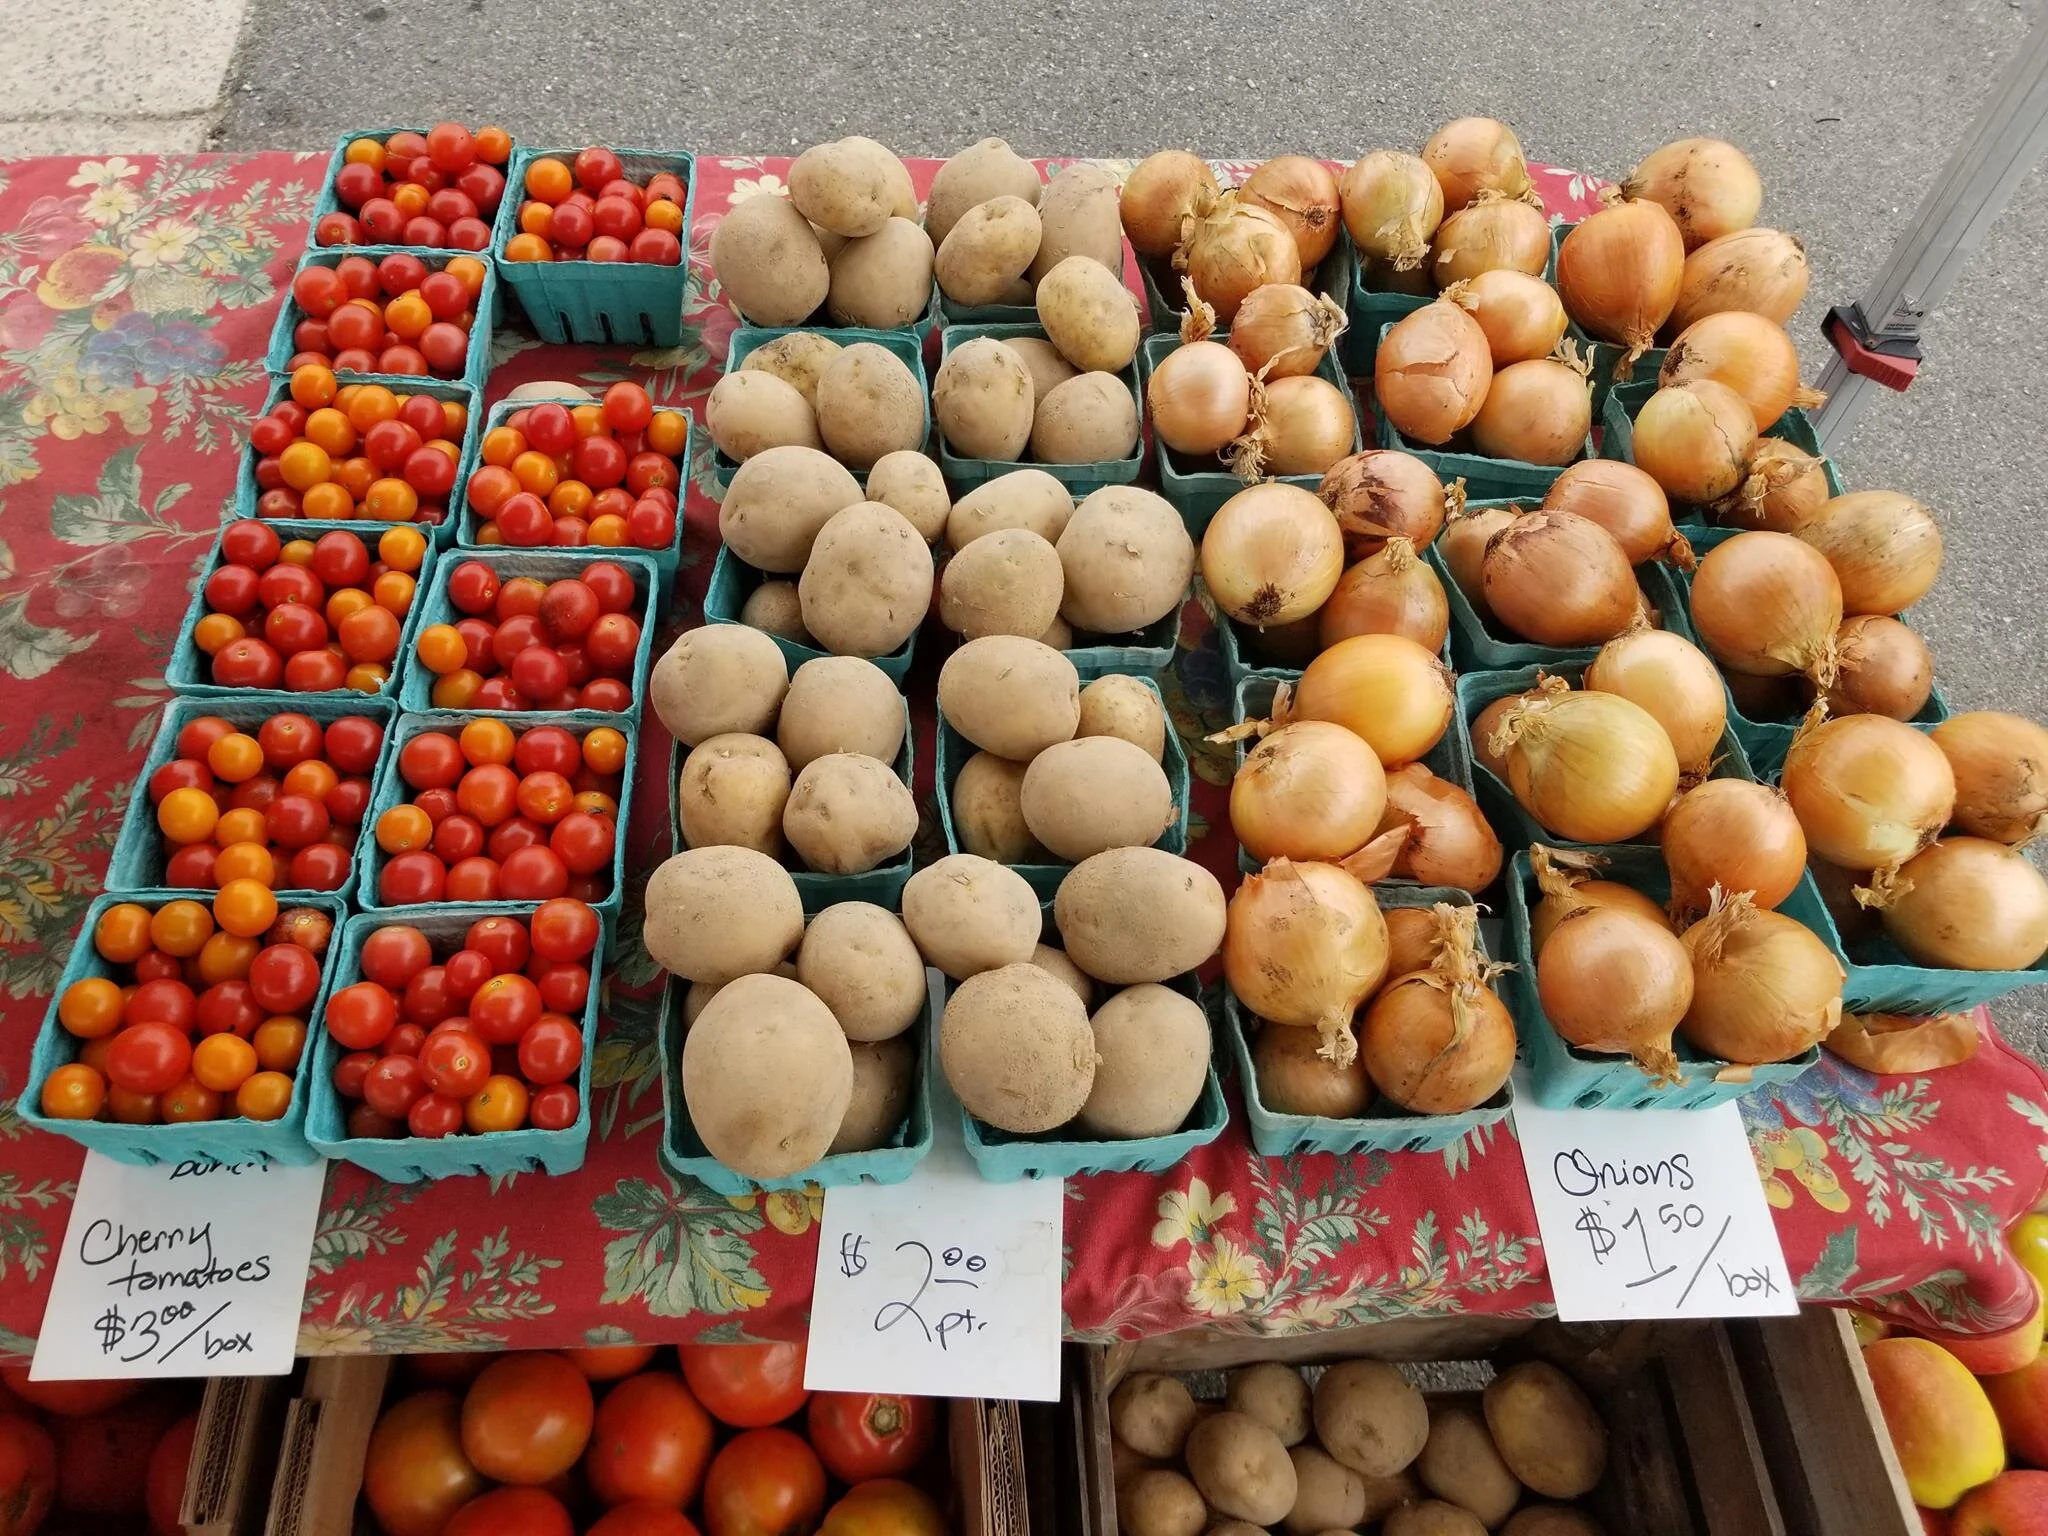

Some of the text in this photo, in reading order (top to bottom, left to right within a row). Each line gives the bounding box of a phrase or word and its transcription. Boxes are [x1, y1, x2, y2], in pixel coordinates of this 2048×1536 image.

[1553, 1148, 1694, 1197] Onions
[80, 1218, 213, 1267] Cherry
[107, 1255, 271, 1297] tomatoes
